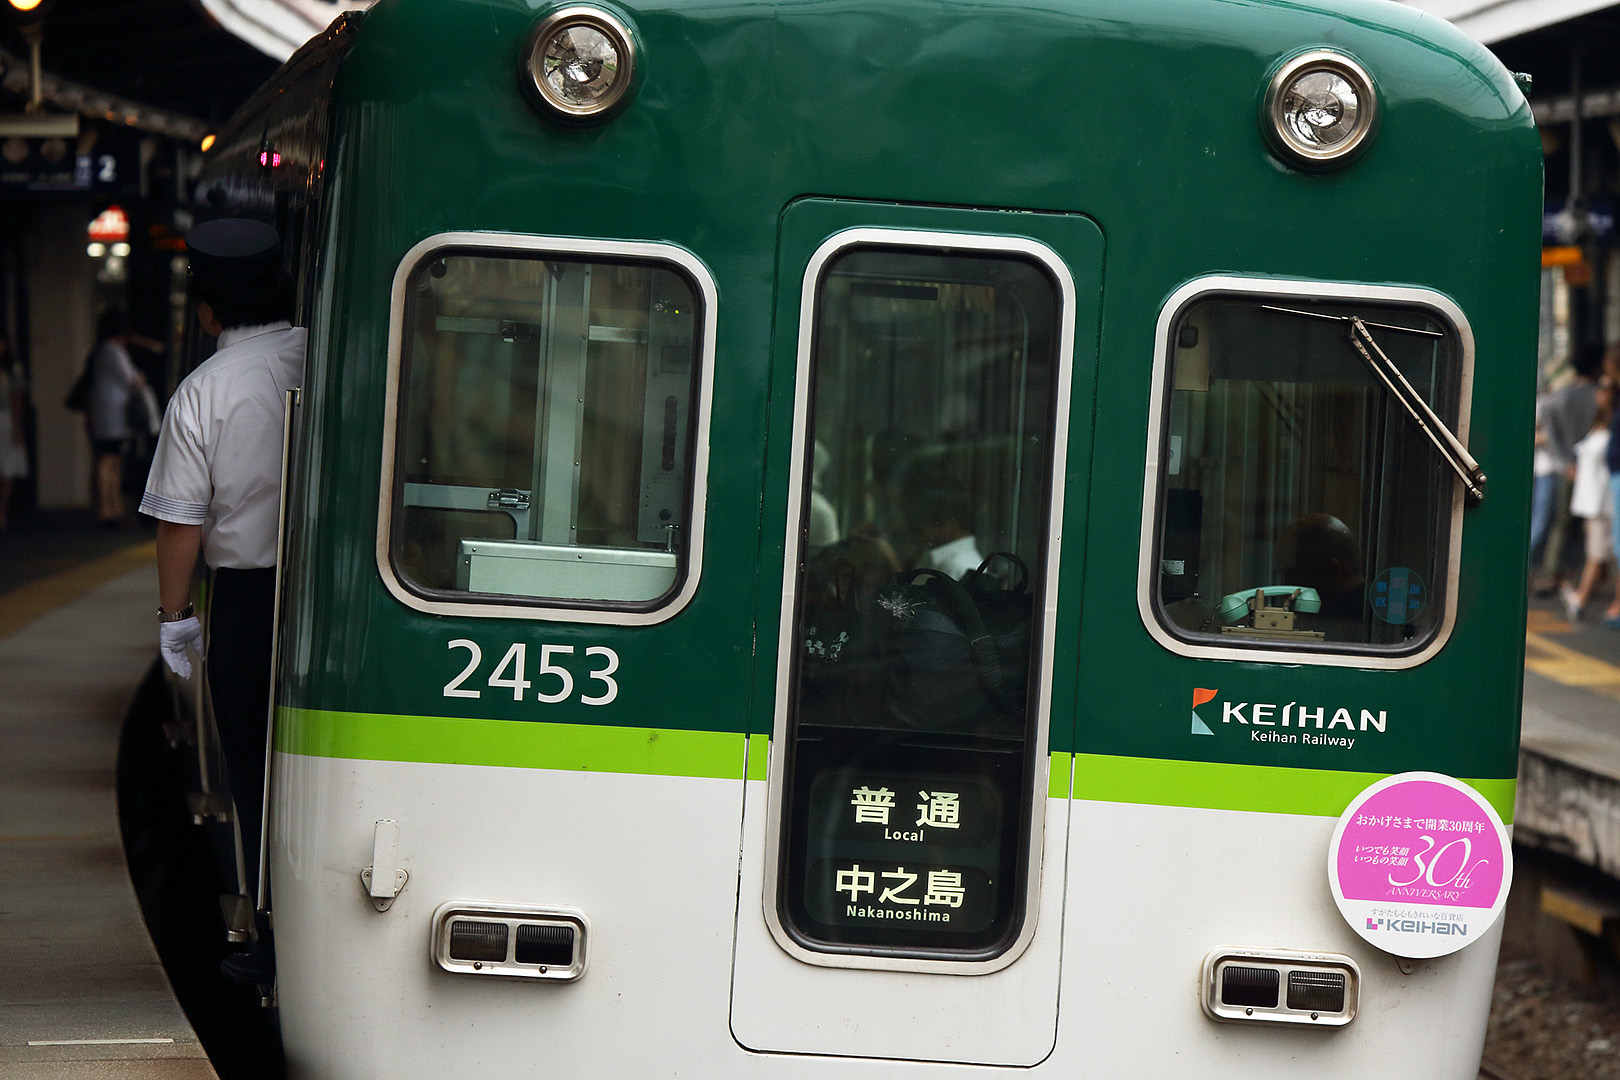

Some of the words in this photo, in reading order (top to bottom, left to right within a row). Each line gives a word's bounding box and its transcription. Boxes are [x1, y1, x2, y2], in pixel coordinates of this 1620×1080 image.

[443, 638, 620, 706] 2453
[1222, 701, 1387, 733] KEIHAN
[1251, 730, 1297, 744] Keihan
[1302, 733, 1356, 749] Railway
[851, 786, 961, 829] 普通
[1356, 814, 1486, 834] おかげさまで開業30周年
[884, 828, 924, 842] Local
[1355, 845, 1410, 857] いつでも笑顔
[1354, 855, 1409, 867] いつもの笑顔
[835, 864, 966, 908] 中之島
[1386, 887, 1466, 901] ANNIVERSARY
[846, 905, 950, 922] Nakanoshima
